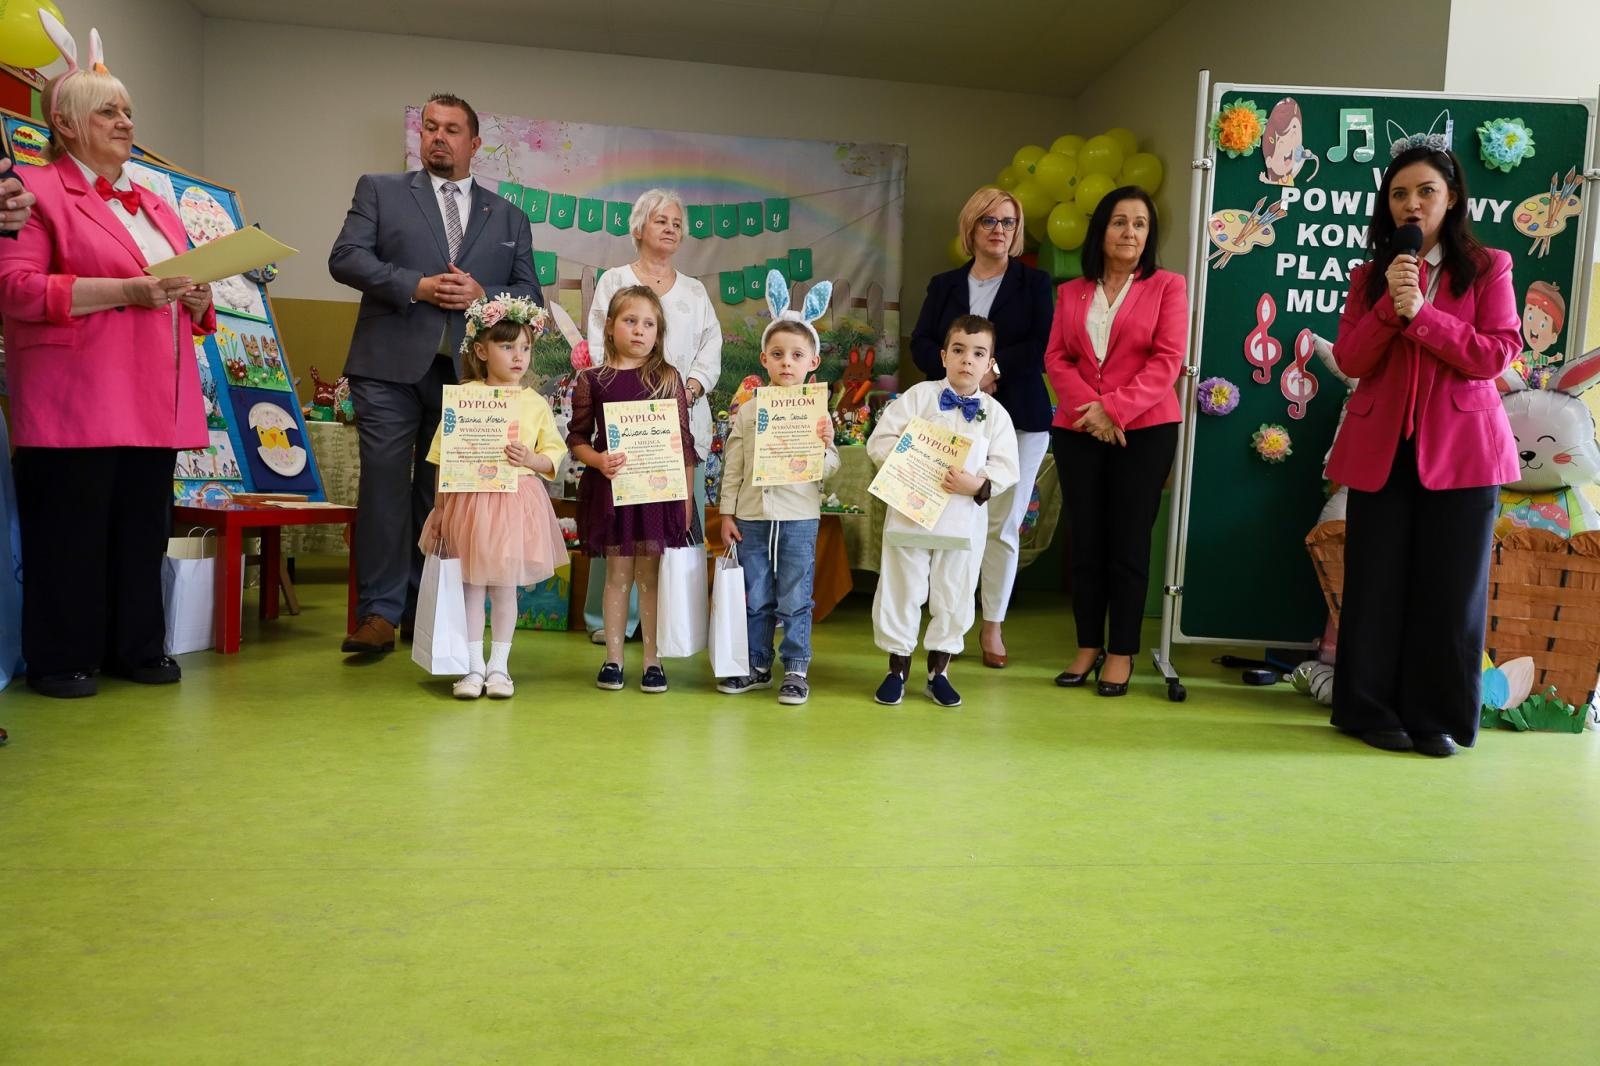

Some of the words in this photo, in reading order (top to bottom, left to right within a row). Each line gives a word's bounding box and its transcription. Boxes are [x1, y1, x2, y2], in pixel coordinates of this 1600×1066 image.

[1280, 186, 1512, 223] POWIWY
[1296, 222, 1377, 249] KON
[1275, 253, 1374, 281] PLAS
[459, 400, 507, 409] DYPLOM
[771, 398, 815, 408] DYPLOM
[620, 413, 666, 424] DYPLOM
[917, 433, 959, 457] DYPLOM
